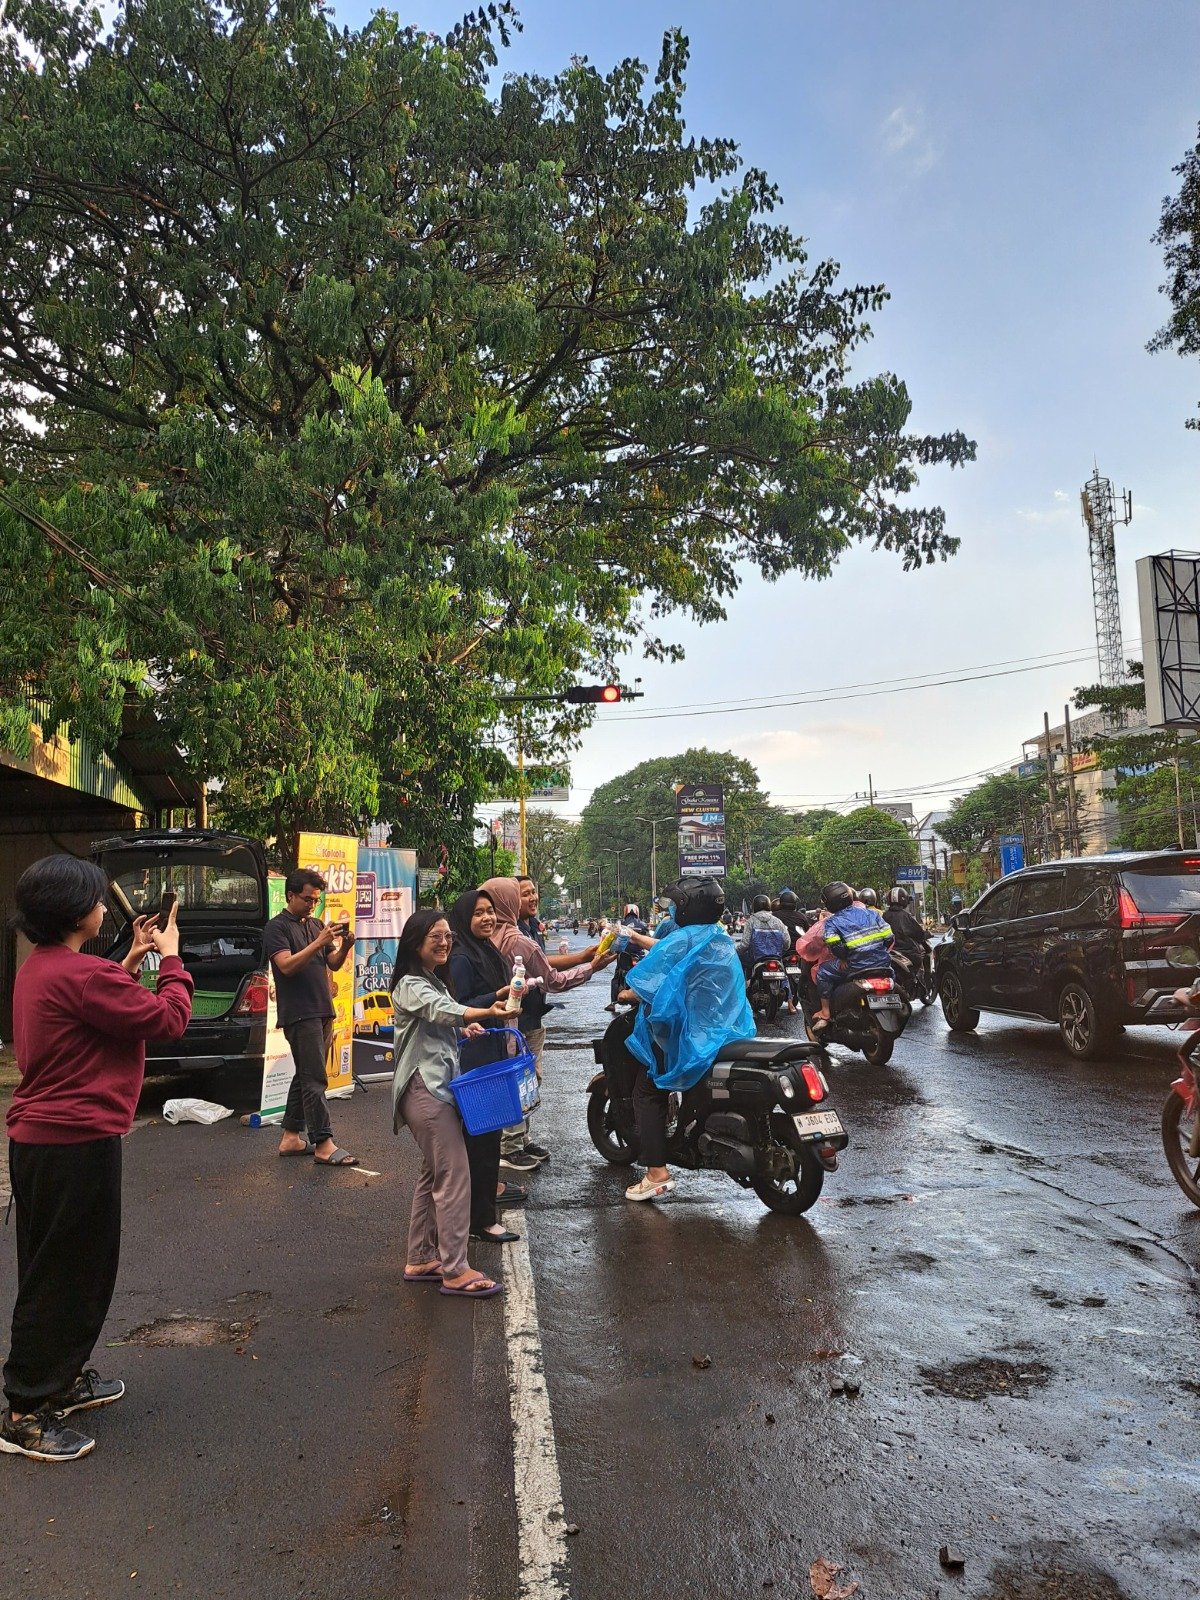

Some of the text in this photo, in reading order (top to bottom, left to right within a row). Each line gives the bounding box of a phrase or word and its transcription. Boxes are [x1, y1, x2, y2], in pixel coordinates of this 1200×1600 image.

[322, 848, 346, 858] Kokola
[359, 890, 372, 903] FM
[358, 961, 395, 977] Bagi Tak
[364, 977, 391, 991] GRAT
[797, 1113, 837, 1128] N 3604 EDS
